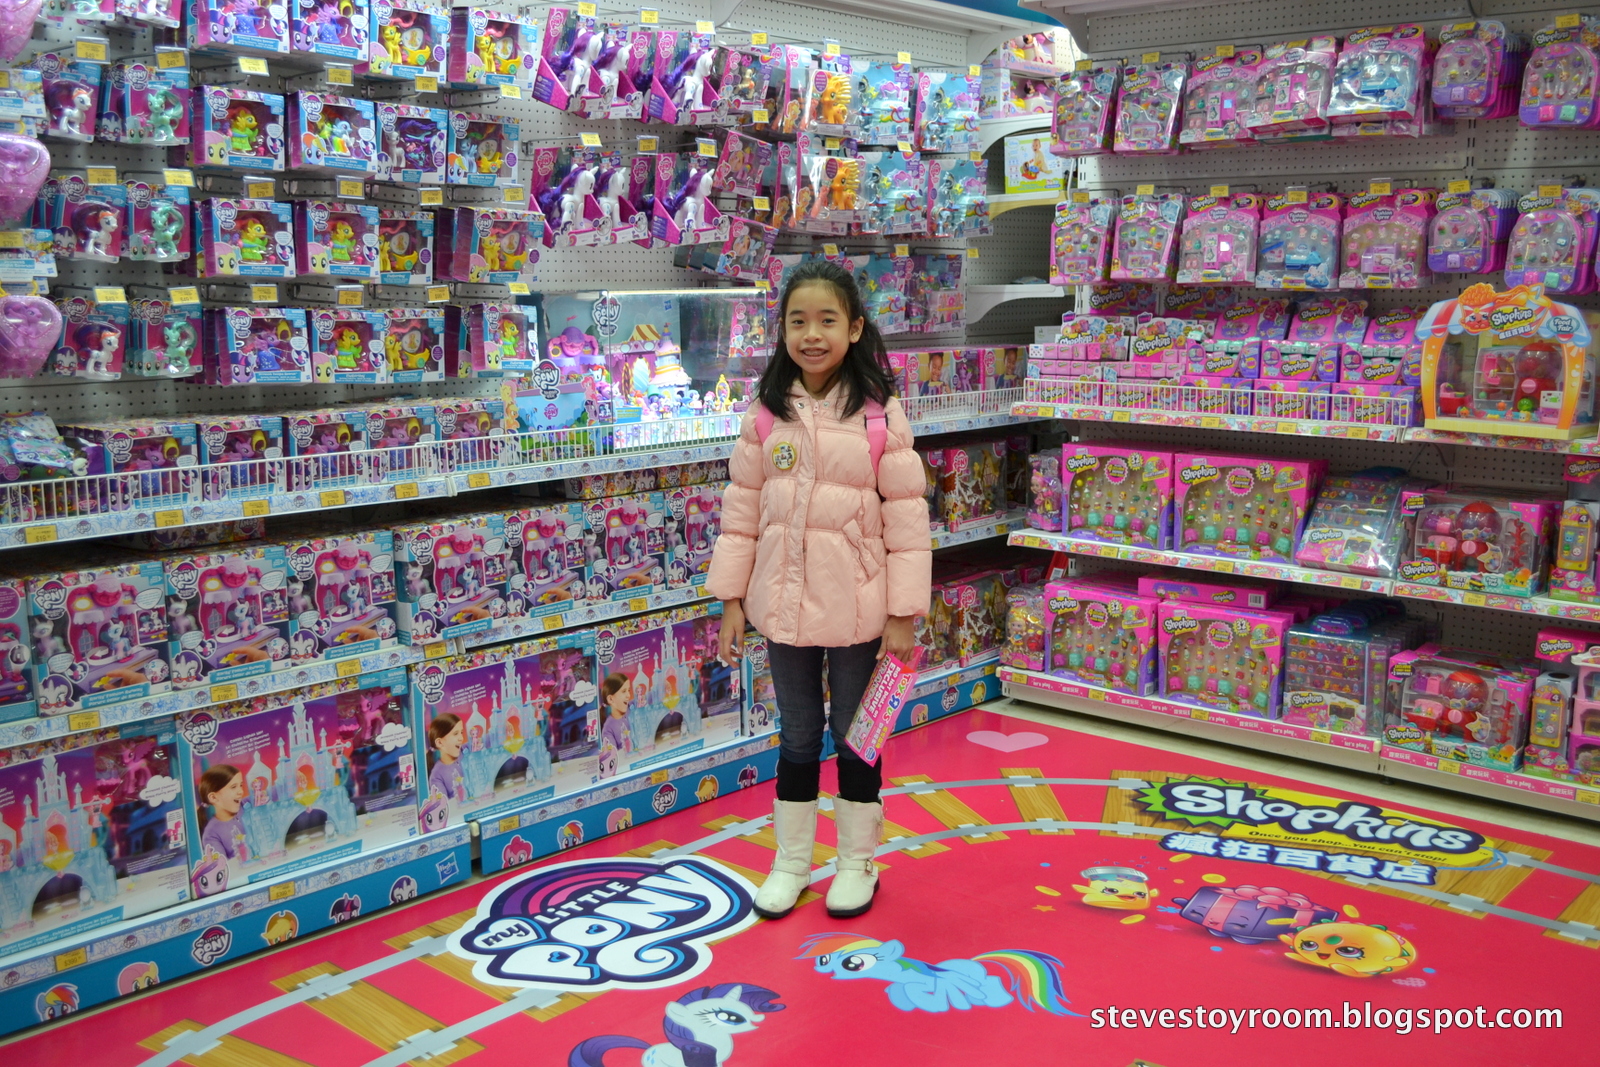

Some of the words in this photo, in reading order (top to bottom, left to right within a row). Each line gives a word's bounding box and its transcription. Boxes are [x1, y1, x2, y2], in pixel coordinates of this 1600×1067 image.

[1491, 307, 1533, 325] Shopkins
[1554, 318, 1573, 326] Food
[1557, 325, 1572, 333] Fair
[1135, 336, 1172, 353] Shopkins
[534, 369, 560, 388] PONY
[1067, 455, 1096, 469] Shopkins
[1181, 465, 1217, 480] Shopkins
[1311, 529, 1343, 541] Shopkins
[411, 538, 433, 554] PONY
[290, 556, 315, 572] PONY
[1402, 562, 1436, 576] Shopkins
[170, 572, 198, 588] PONY
[35, 591, 67, 608] PONY
[1164, 616, 1197, 630] Shopkins
[419, 673, 446, 694] PONY
[868, 662, 894, 714] EXCLUSIVE
[1292, 692, 1323, 706] Shopkins
[185, 720, 216, 744] PONY
[1388, 728, 1421, 739] Shopkins
[653, 791, 677, 812] PONY
[1170, 784, 1473, 850] Shopkins
[1248, 831, 1282, 839] Once
[1284, 834, 1308, 842] you
[1378, 846, 1412, 856] can't
[1413, 852, 1448, 862] stop!
[1165, 833, 1431, 885] 瘋狂百貨店
[500, 863, 732, 981] PONY
[194, 933, 230, 965] PONY
